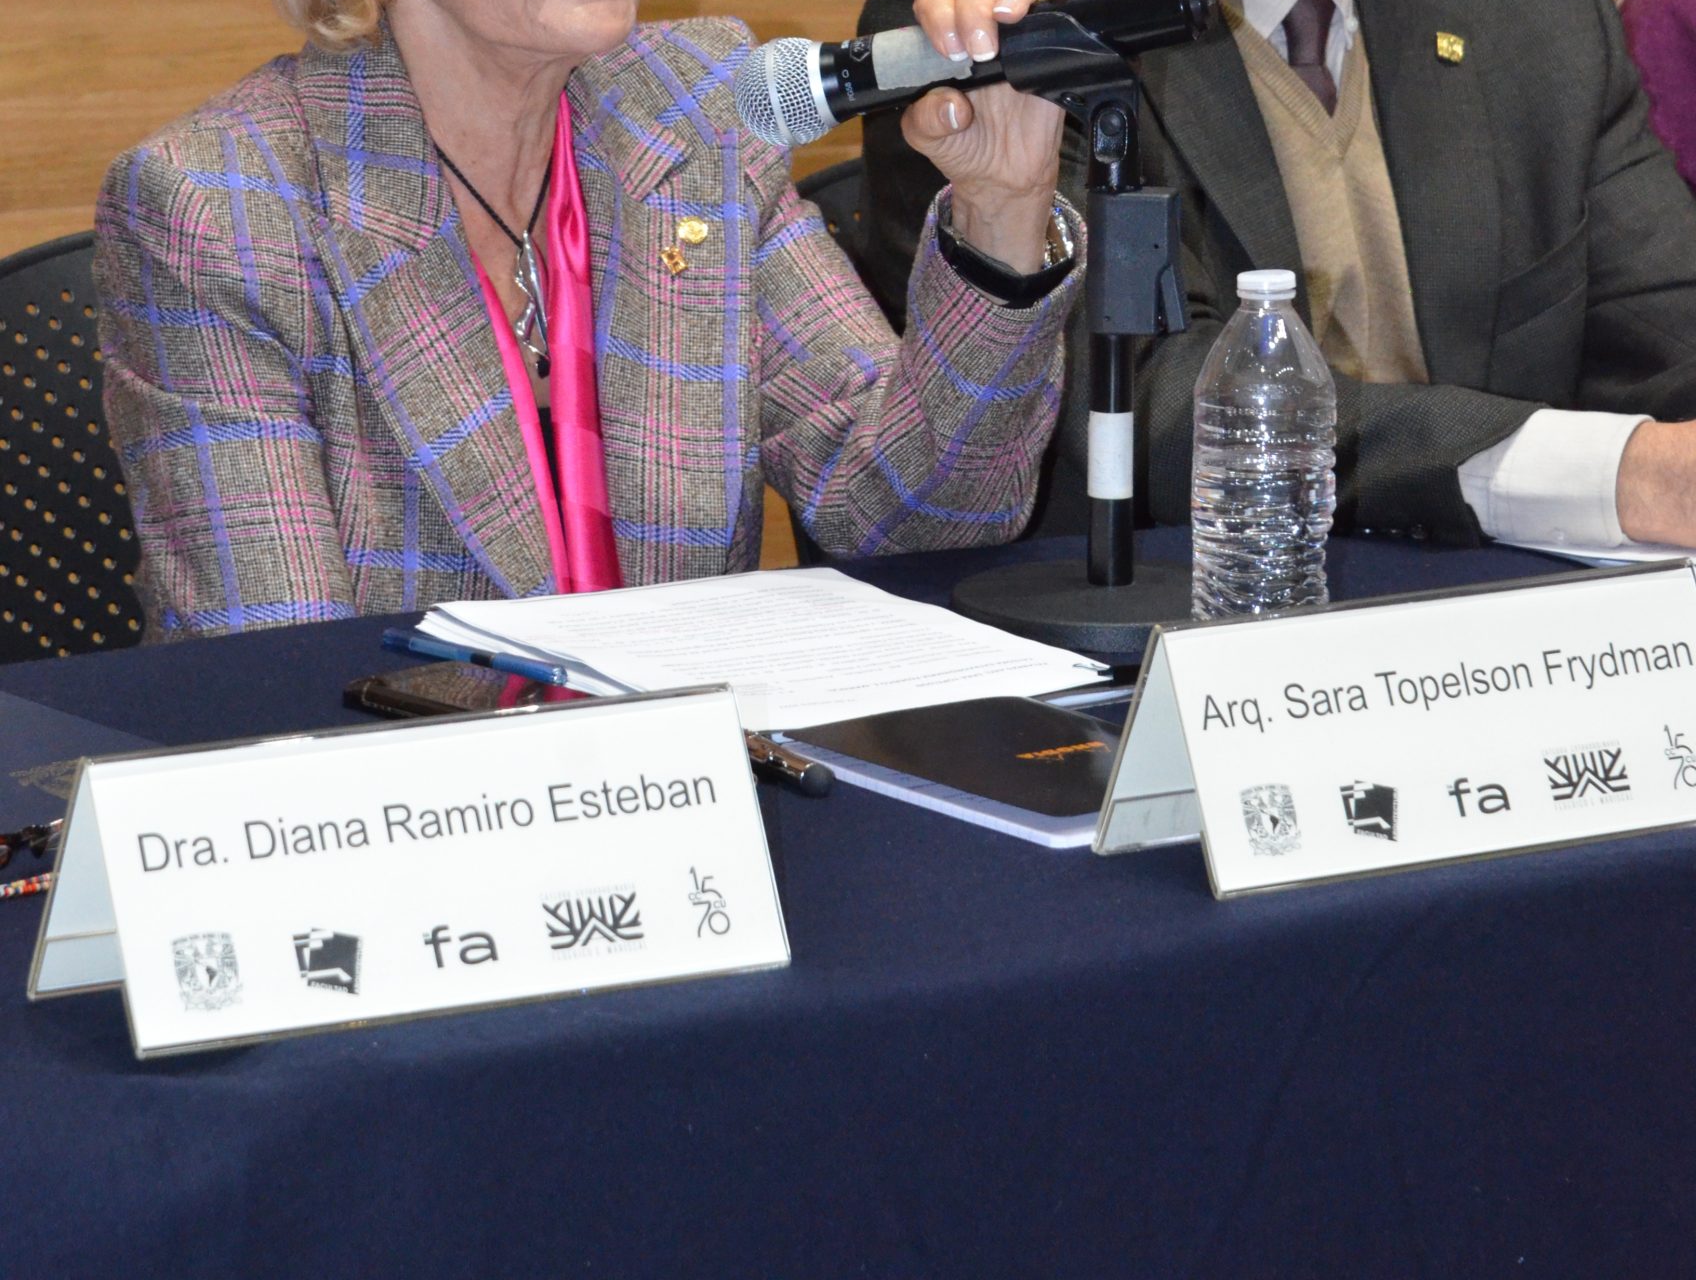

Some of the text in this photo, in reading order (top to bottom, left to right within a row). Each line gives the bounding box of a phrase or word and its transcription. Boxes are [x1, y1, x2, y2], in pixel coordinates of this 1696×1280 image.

[1203, 639, 1694, 734] Arq. Sara Topelson Frydman
[137, 773, 717, 872] Dra. Diana Ramiro Esteban
[1448, 777, 1511, 818] fa
[424, 924, 499, 969] fa
